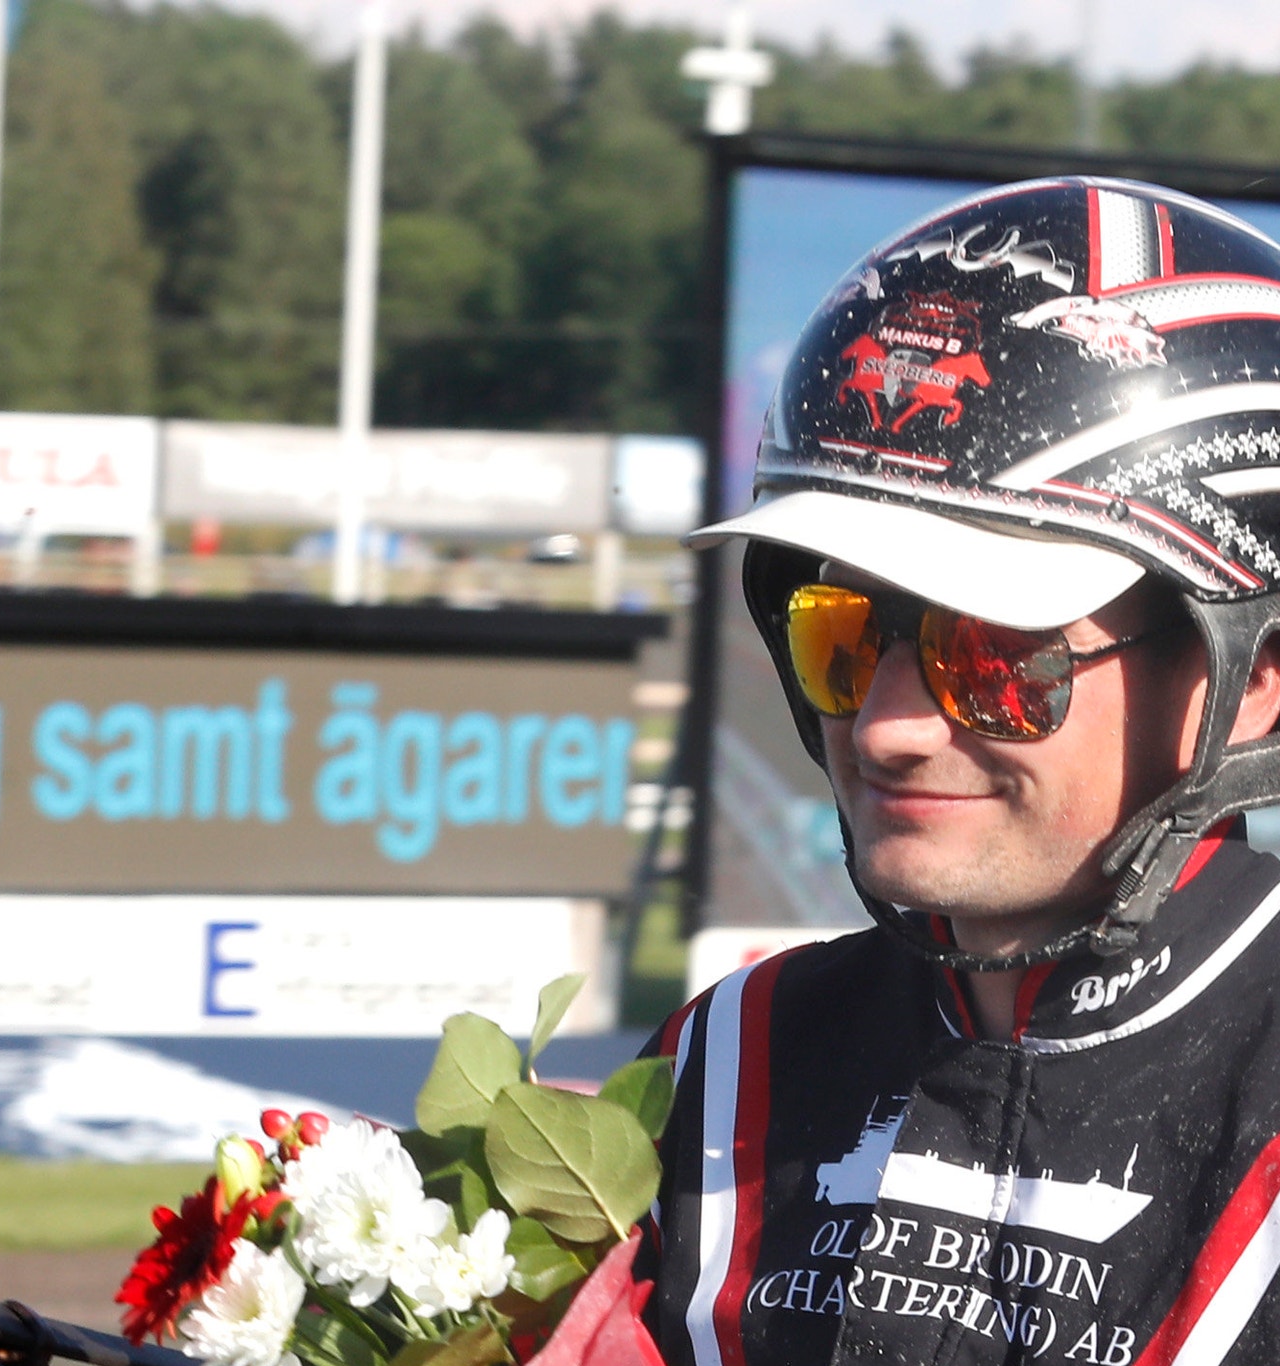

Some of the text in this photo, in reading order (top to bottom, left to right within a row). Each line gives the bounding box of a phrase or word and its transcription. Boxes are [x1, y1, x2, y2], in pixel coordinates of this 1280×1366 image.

[860, 355, 957, 388] SVEDBERG
[877, 326, 962, 354] MARKUS B
[31, 678, 290, 824] samt
[810, 1212, 1114, 1305] OLOF BRODIN
[746, 1264, 1058, 1359] (CHARTERING)
